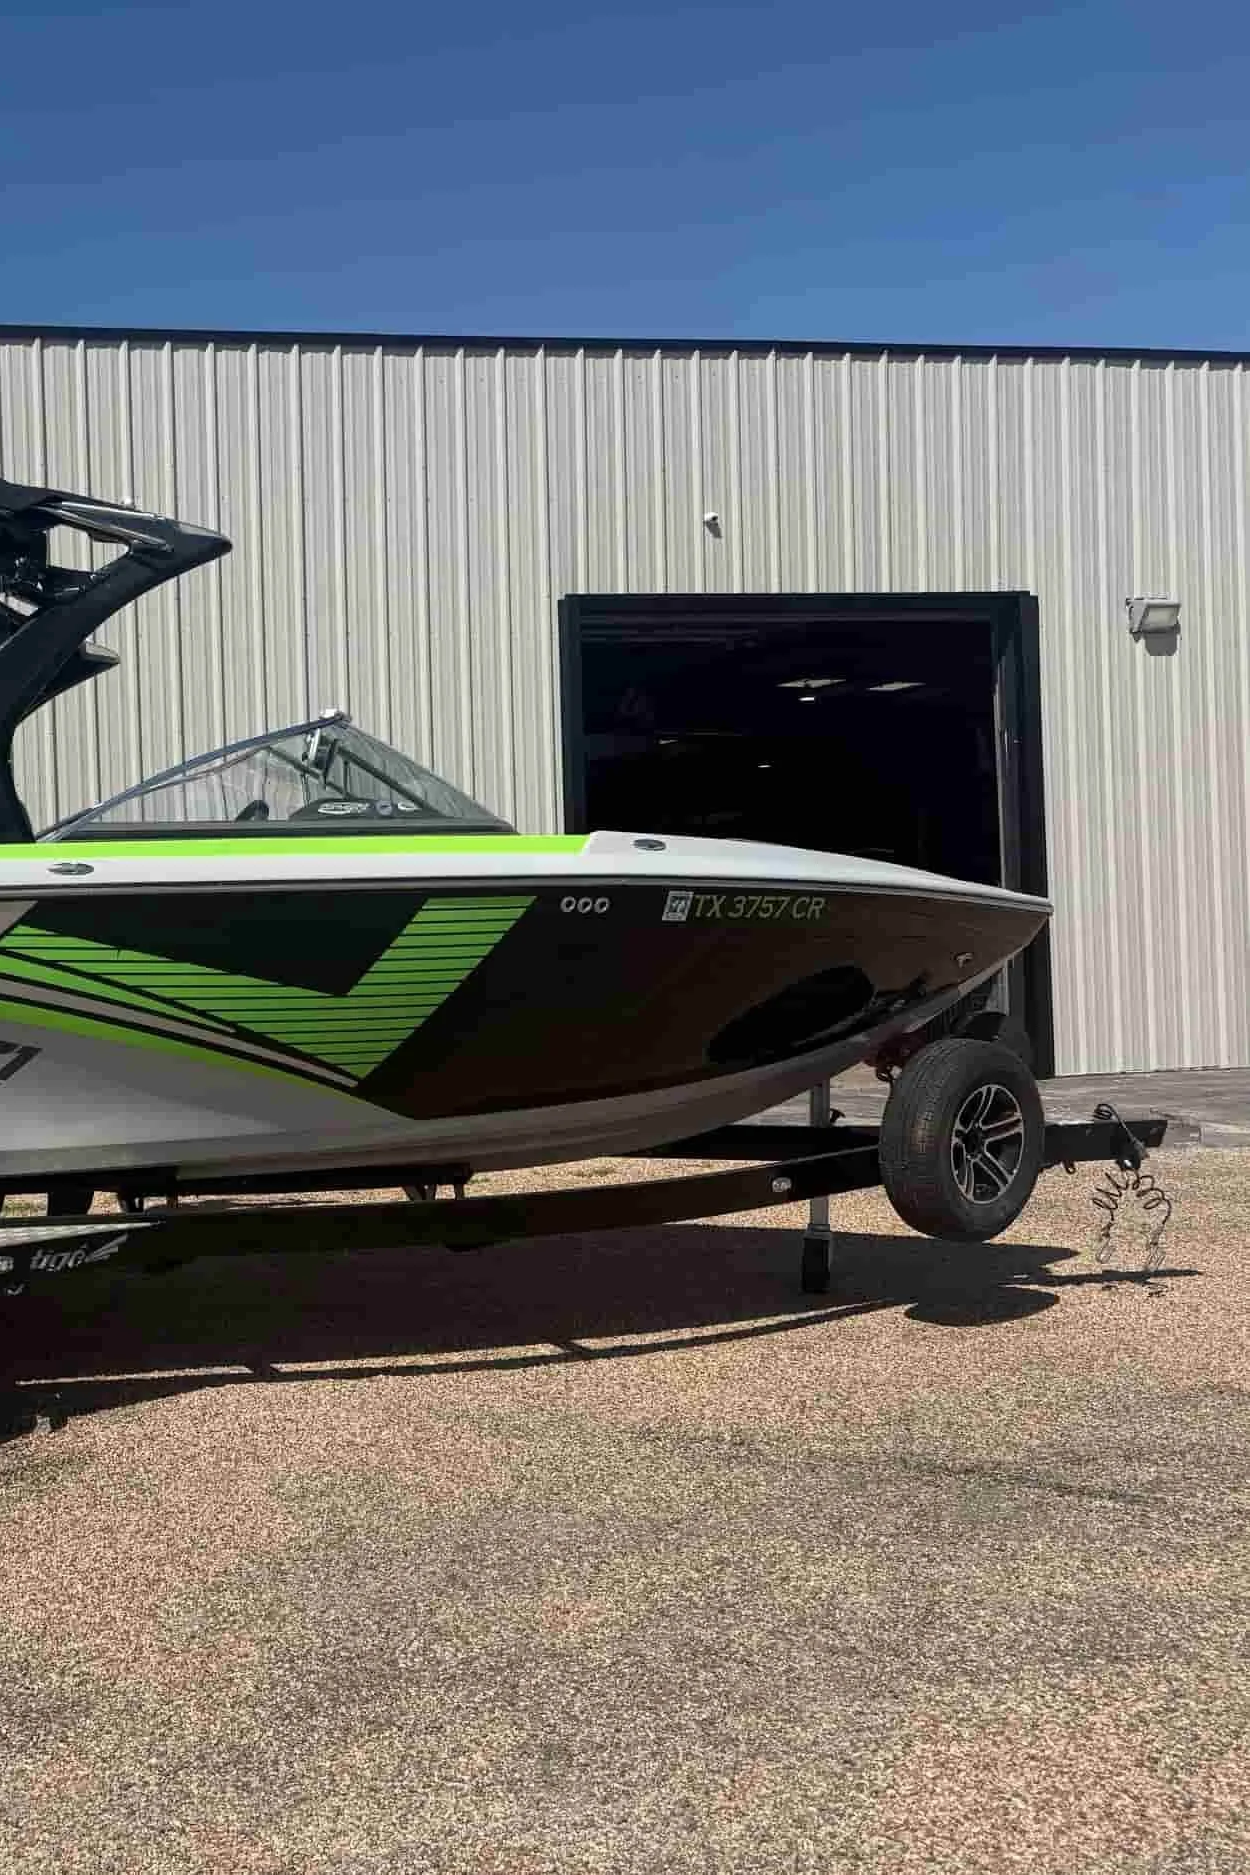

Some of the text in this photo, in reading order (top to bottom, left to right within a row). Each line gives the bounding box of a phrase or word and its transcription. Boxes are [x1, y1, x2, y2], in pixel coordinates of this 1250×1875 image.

[694, 896, 727, 918] TX
[727, 895, 791, 919] 3757
[792, 897, 827, 920] CR
